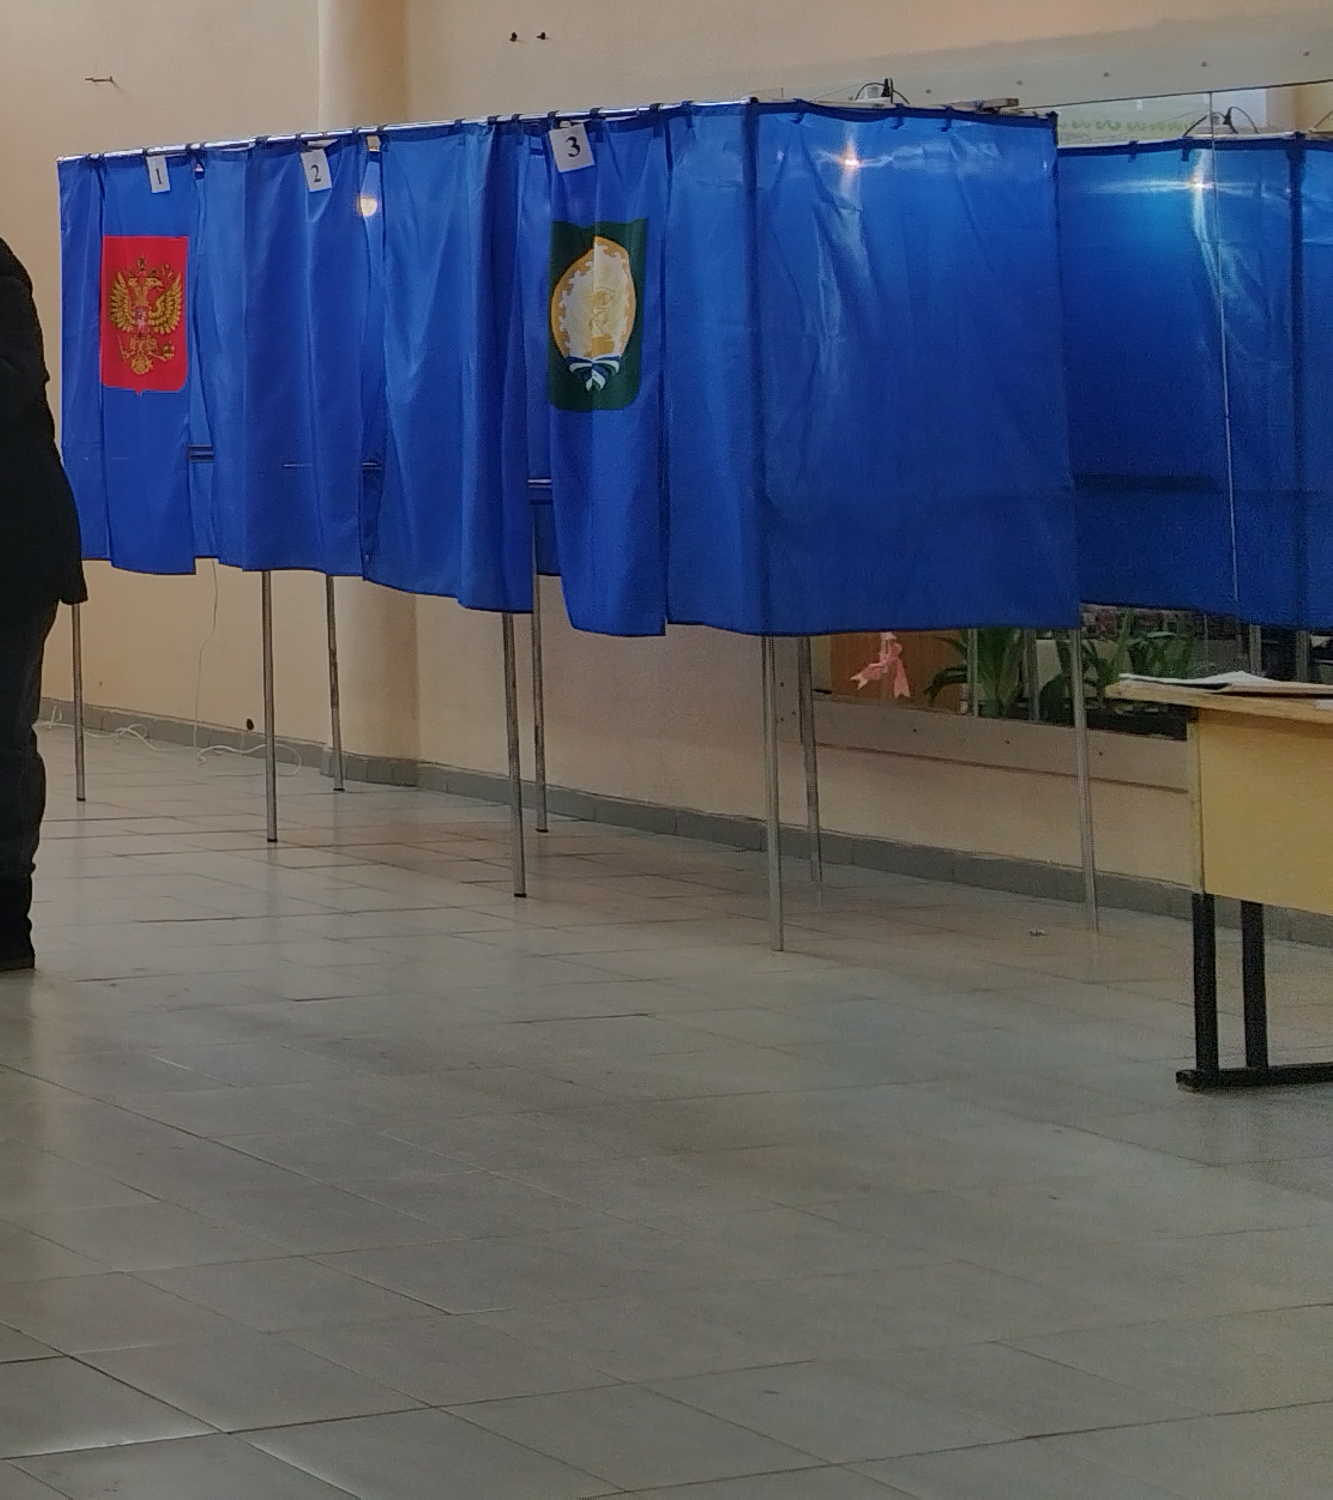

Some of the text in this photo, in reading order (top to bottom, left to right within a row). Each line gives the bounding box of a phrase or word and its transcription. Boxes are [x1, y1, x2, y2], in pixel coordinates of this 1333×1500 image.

[565, 136, 581, 158] 3
[154, 168, 164, 186] 1
[310, 164, 323, 184] 2
